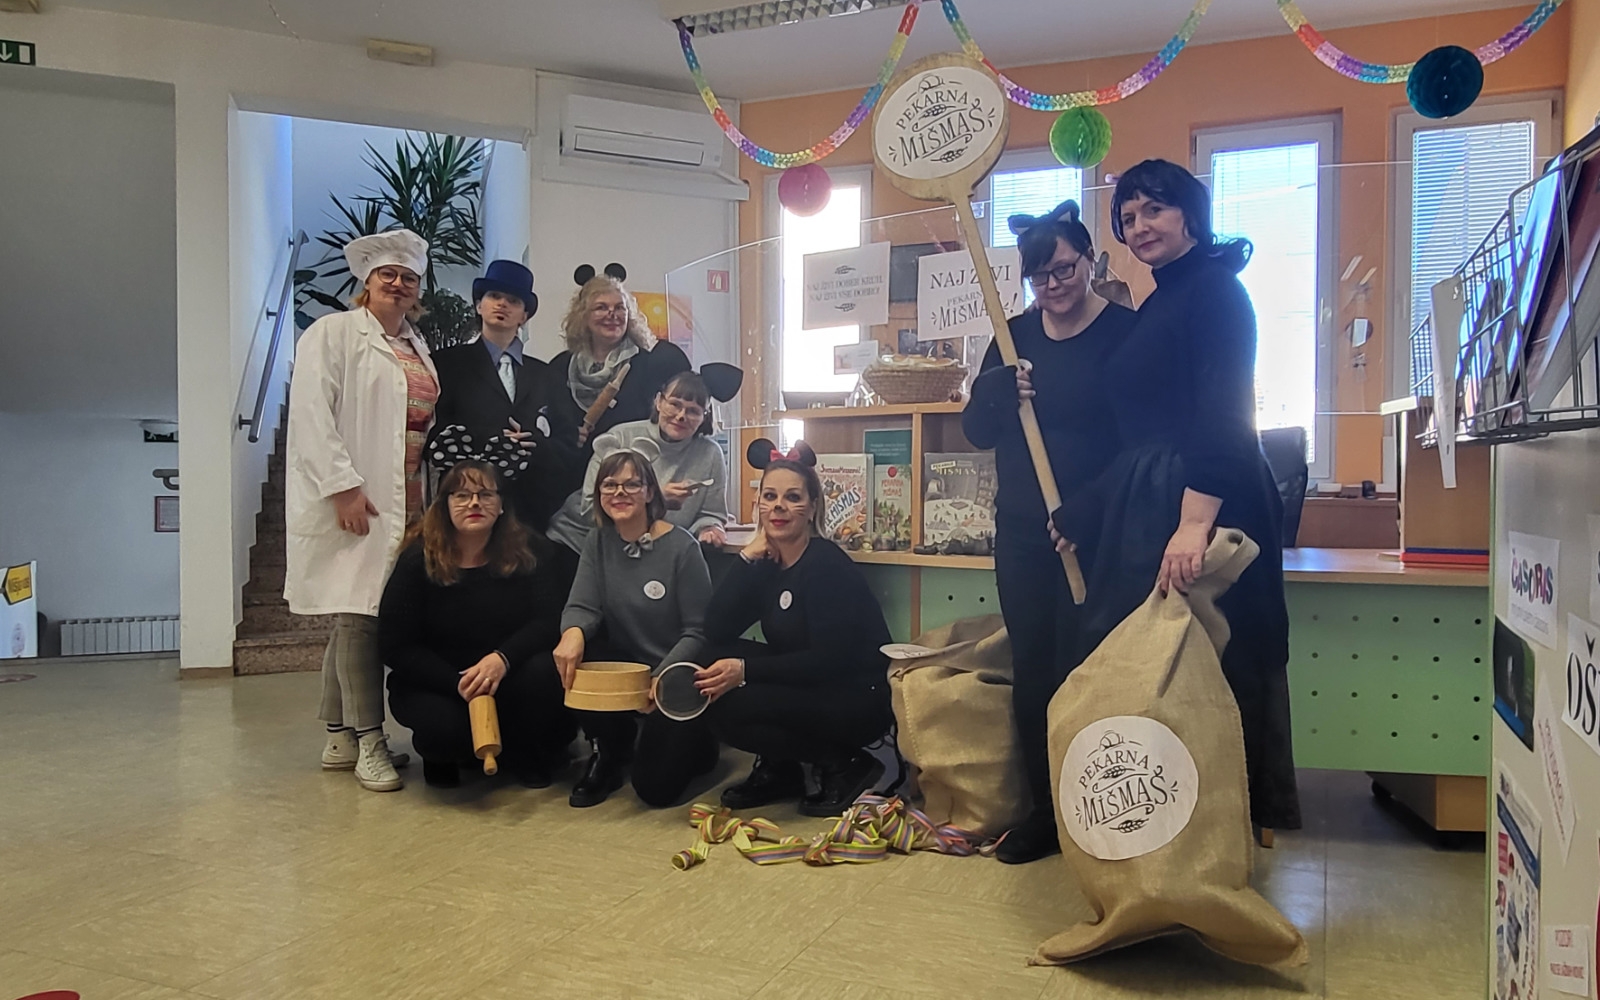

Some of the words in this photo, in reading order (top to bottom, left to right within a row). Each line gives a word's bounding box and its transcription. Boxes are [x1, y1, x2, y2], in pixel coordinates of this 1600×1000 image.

[896, 89, 968, 130] PEKARNA
[930, 269, 965, 290] NAJ
[947, 291, 983, 307] PEKARN
[1078, 750, 1150, 790] PEKARNA
